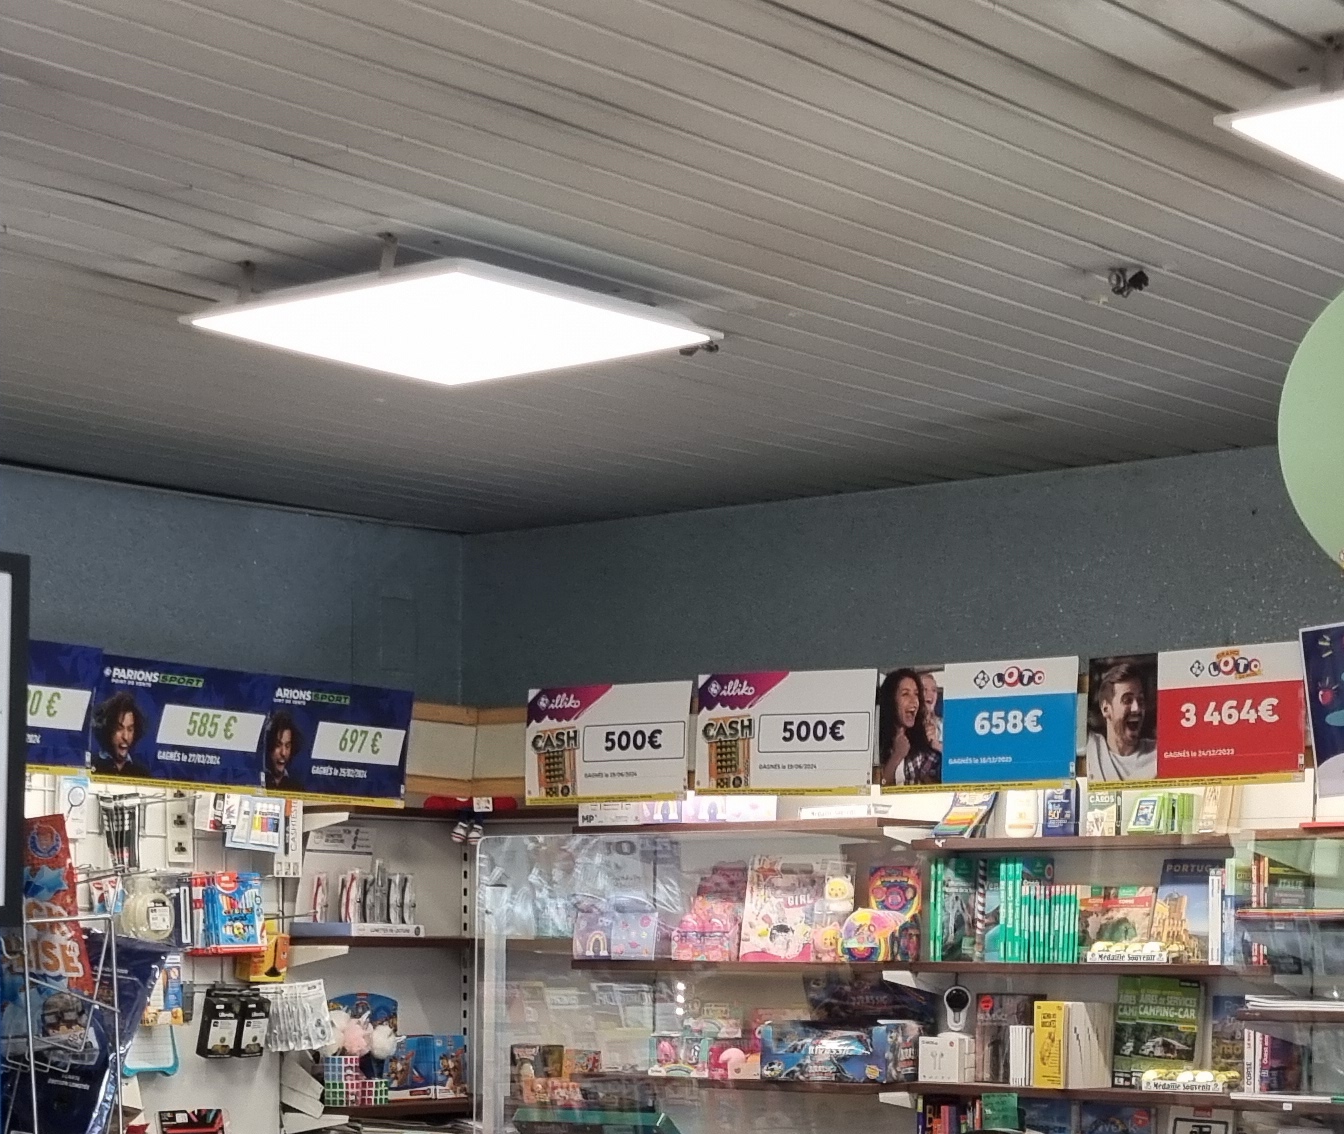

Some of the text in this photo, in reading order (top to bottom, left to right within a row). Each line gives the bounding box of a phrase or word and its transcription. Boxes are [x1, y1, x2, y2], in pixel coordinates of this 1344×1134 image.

[112, 668, 203, 687] PARIONS SPORT
[992, 666, 1045, 687] LOTO
[1208, 656, 1261, 677] LOTO
[186, 712, 237, 740] 585 €
[703, 717, 754, 740] CASH
[782, 720, 845, 743] 500€
[974, 709, 1043, 736] 658€
[532, 730, 579, 754] CASH
[604, 728, 662, 751] 500€
[1138, 1004, 1196, 1019] CAMPING-CAR
